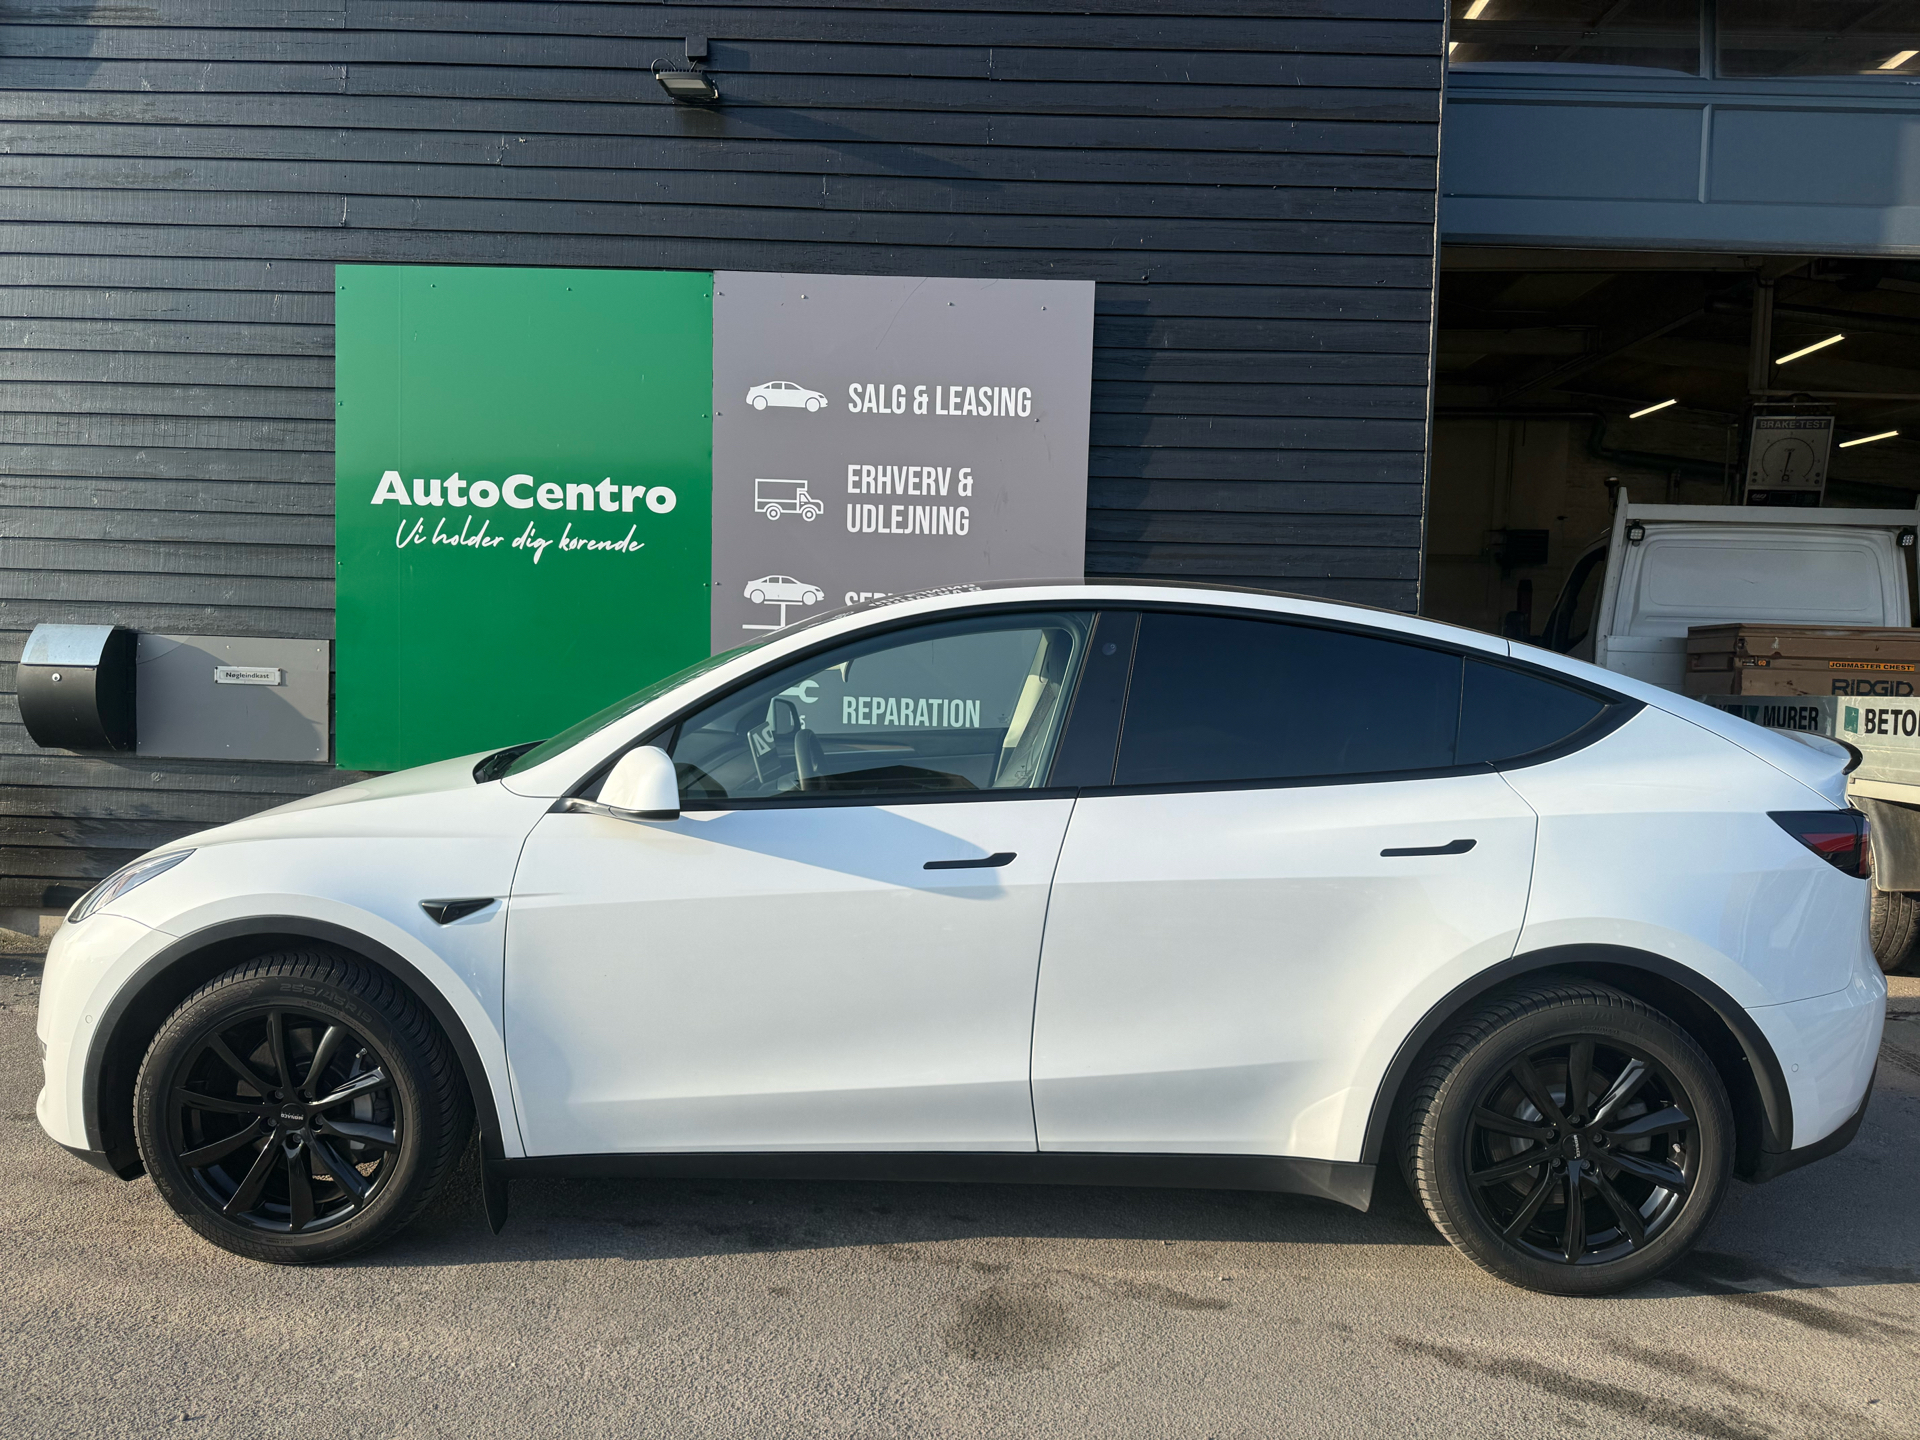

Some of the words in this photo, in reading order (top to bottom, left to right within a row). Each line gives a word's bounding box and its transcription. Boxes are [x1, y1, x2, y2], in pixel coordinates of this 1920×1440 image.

[849, 383, 907, 415] SALG
[913, 385, 929, 415] &
[936, 386, 1032, 418] LEASING
[1760, 420, 1827, 429] BRAKE-TEST
[370, 471, 677, 514] AutoCentro
[848, 465, 952, 496] ERHVERV
[958, 468, 974, 497] &
[847, 504, 970, 536] UDLEJNING
[396, 517, 426, 548] Vi
[432, 515, 505, 549] holder
[512, 521, 554, 565] dig
[558, 522, 645, 553] kørende
[1830, 662, 1881, 670] JOBMASTER
[1831, 678, 1914, 697] RIDGID
[843, 696, 981, 728] REPARATION
[1763, 705, 1819, 731] MURER
